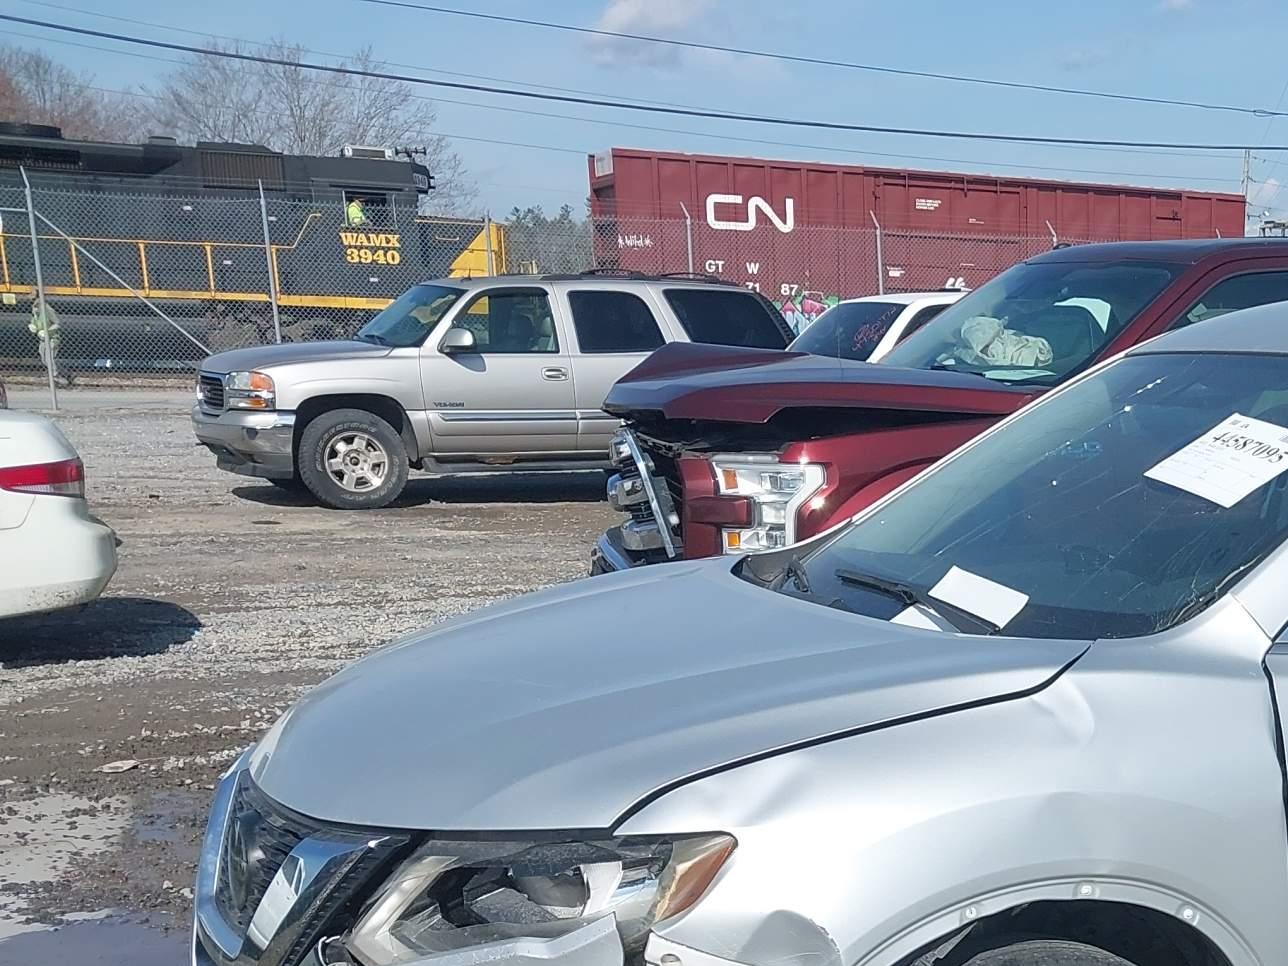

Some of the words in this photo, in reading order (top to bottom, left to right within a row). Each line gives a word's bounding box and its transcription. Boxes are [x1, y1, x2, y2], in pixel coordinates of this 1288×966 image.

[706, 193, 795, 233] CN
[339, 232, 401, 247] WAMX
[346, 248, 401, 265] 3940
[705, 260, 725, 273] GT
[746, 262, 760, 275] W
[780, 284, 799, 296] 87
